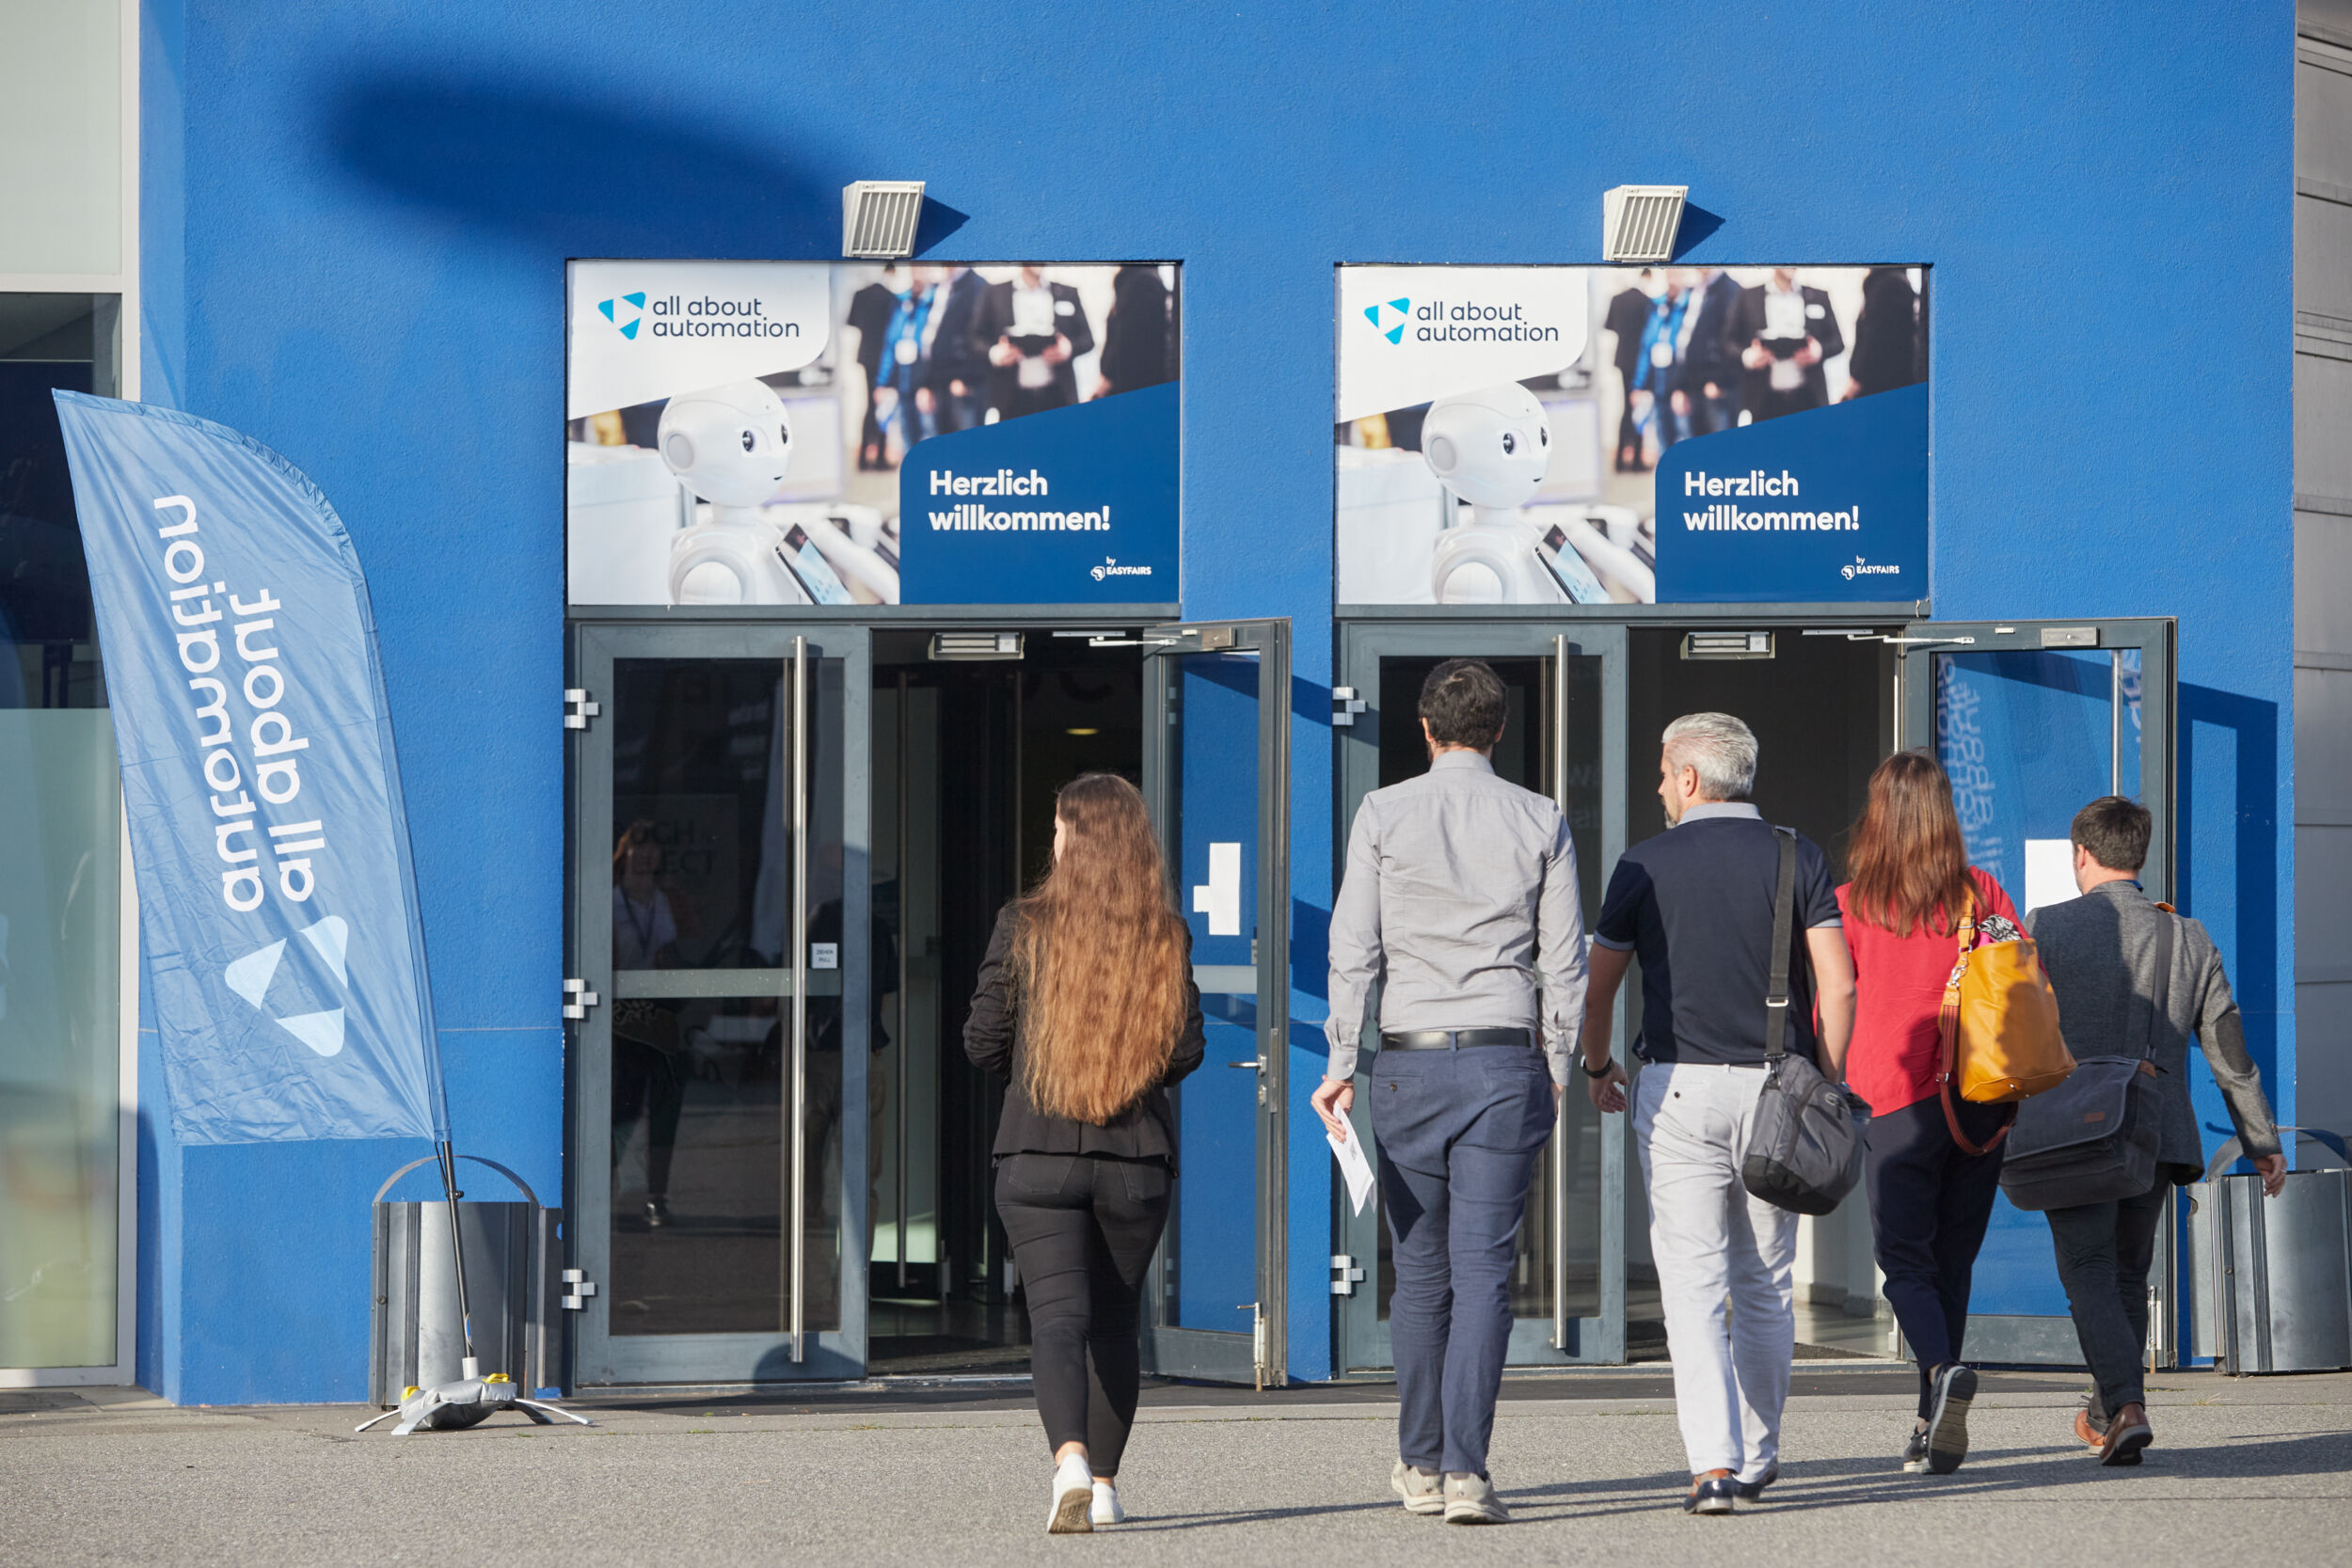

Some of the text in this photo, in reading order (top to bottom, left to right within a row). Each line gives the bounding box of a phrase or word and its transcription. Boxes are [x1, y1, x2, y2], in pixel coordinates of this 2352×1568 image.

[652, 295, 762, 316] all about
[1417, 301, 1522, 321] all about
[653, 316, 800, 338] automation
[1417, 321, 1559, 341] automation
[930, 468, 1048, 496] Herzlich
[1685, 469, 1799, 497] Herzlich
[929, 504, 1111, 531] willkommen!
[1684, 504, 1860, 531] willkommen!
[1105, 556, 1117, 566] by
[1855, 555, 1866, 566] by
[1856, 565, 1900, 575] EASYFAIRS
[1106, 566, 1152, 576] EASYFAIRS
